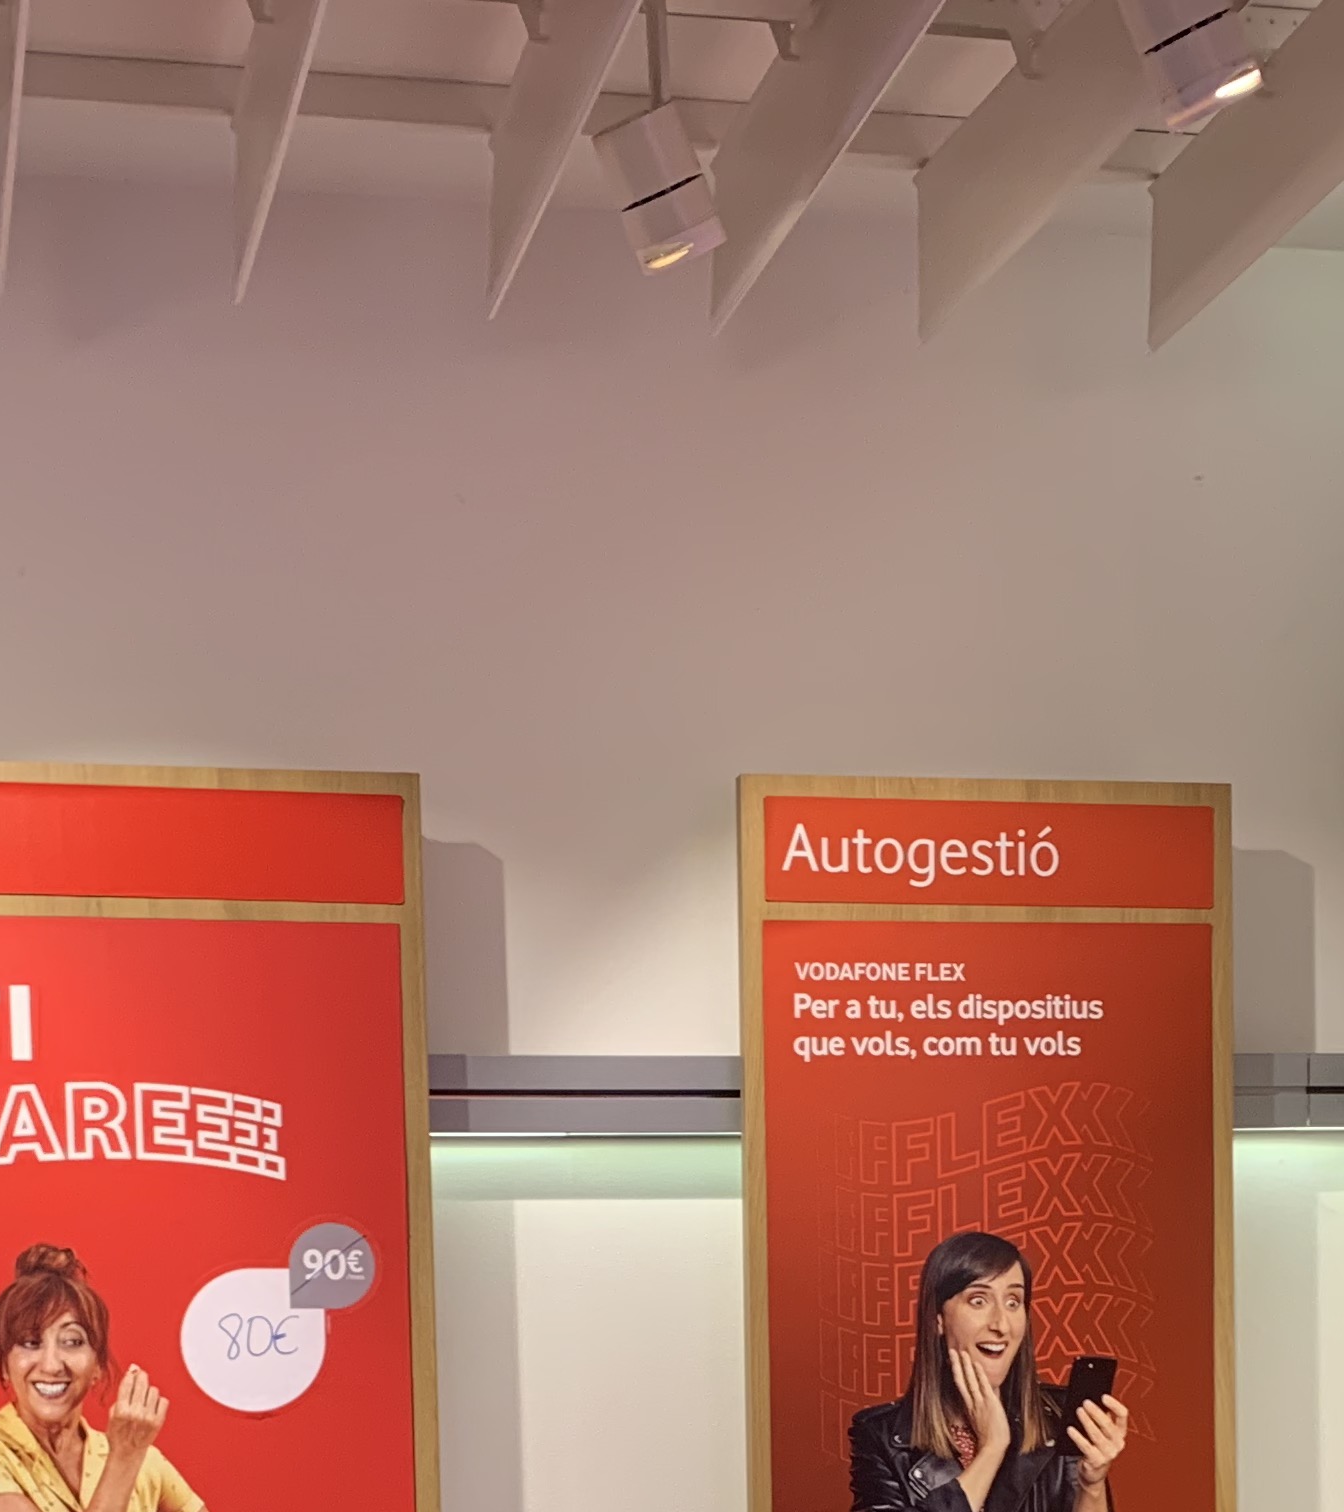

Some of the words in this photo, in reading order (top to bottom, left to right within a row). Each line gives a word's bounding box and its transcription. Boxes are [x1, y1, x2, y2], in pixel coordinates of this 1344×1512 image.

[782, 823, 1060, 888] Autogestió
[795, 962, 911, 981] VODAFONE
[915, 962, 966, 981] FLEX
[793, 993, 839, 1019] Per
[845, 1000, 861, 1019] a
[868, 995, 904, 1022] tu,
[910, 994, 952, 1019] els
[958, 994, 1104, 1025] dispositius
[793, 1035, 846, 1062] que
[851, 1031, 917, 1059] vols,
[923, 1036, 982, 1056] com
[988, 1033, 1017, 1056] tu
[1023, 1031, 1081, 1056] vols
[303, 1248, 365, 1280] 90€
[218, 1312, 300, 1361] 80€
